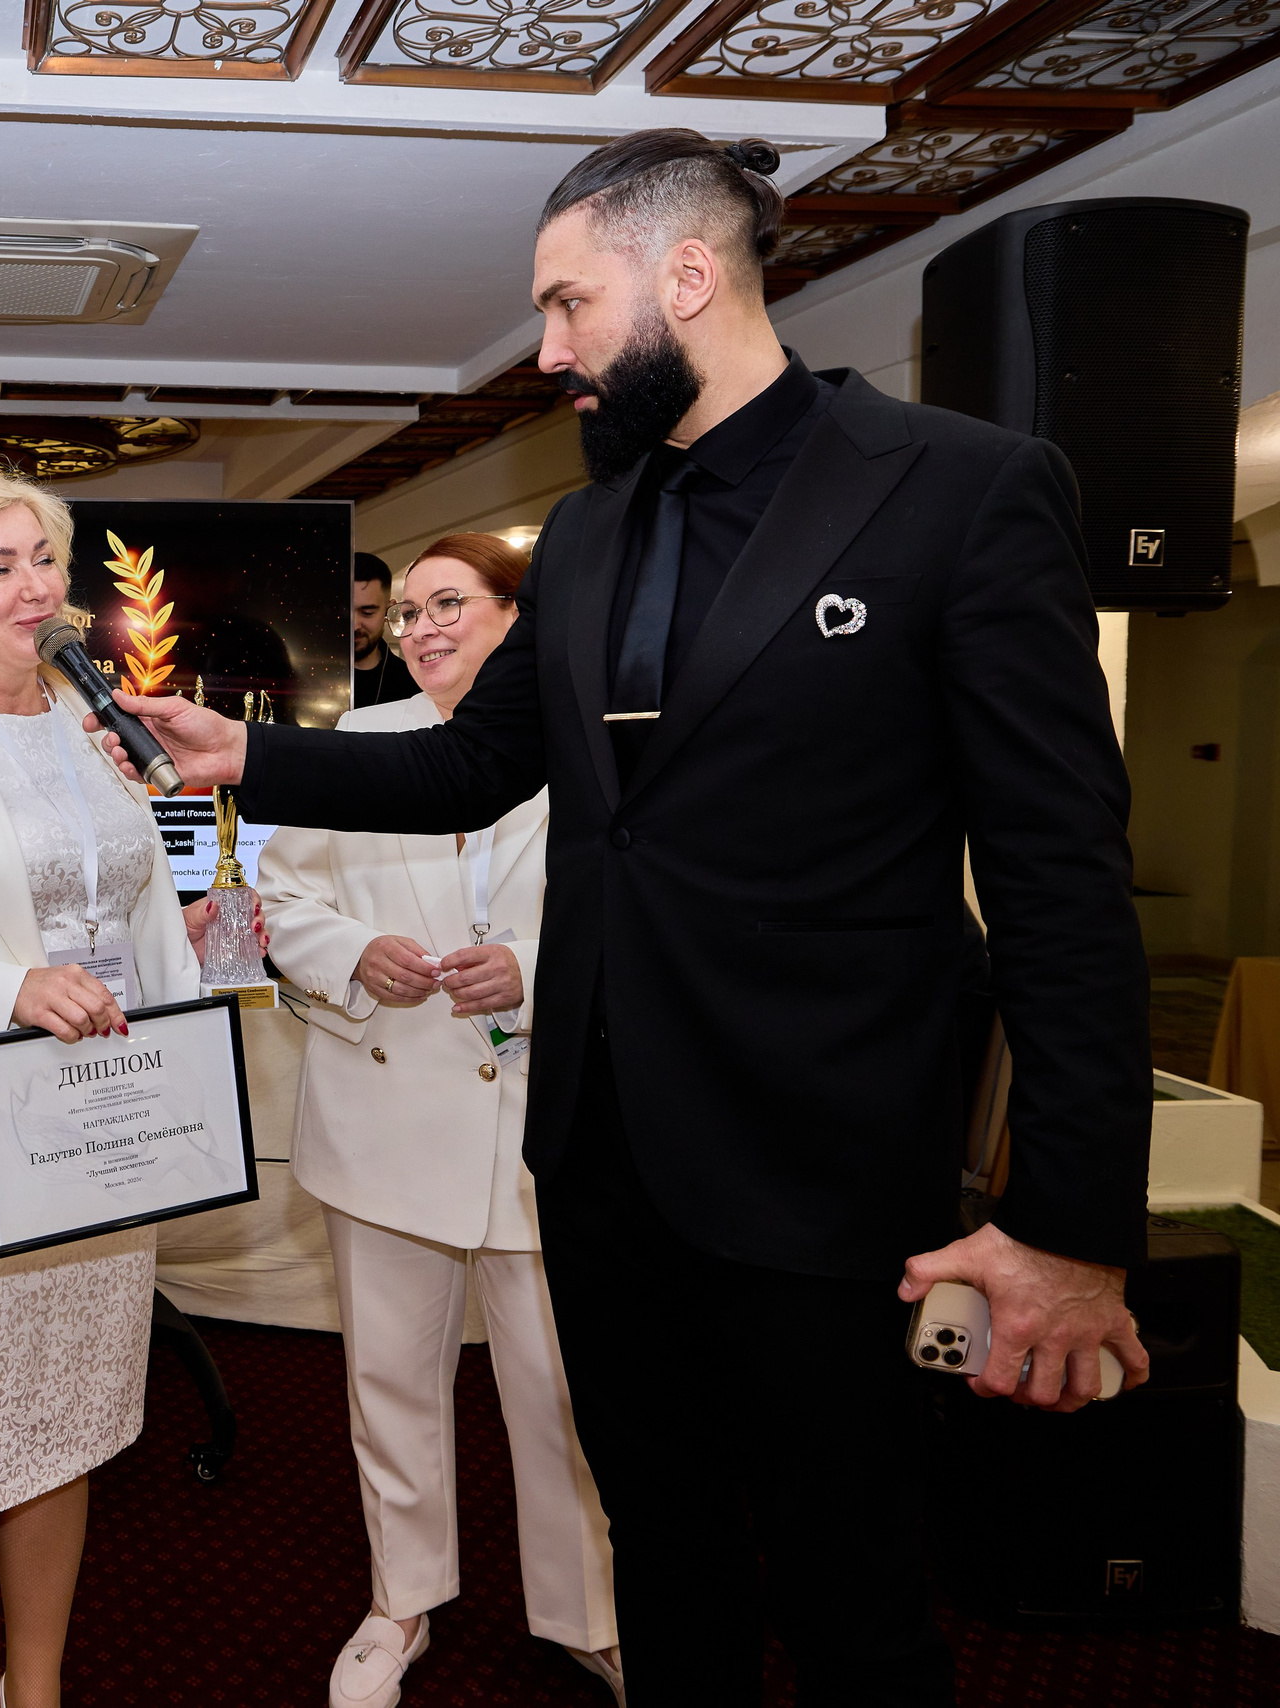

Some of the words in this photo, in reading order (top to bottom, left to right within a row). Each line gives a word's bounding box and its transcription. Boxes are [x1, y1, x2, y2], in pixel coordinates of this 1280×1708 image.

[58, 1049, 164, 1091] ДИПЛОМ
[92, 1082, 135, 1096] ПОБЕДИТЕЛЯ
[83, 1109, 150, 1130] НАГРАЖДАЕТСЯ
[30, 1147, 83, 1166] Галутво
[85, 1136, 135, 1155] Полина
[137, 1121, 204, 1143] Семёновна
[86, 1166, 118, 1178] "Лучший
[119, 1156, 159, 1172] косметолог"
